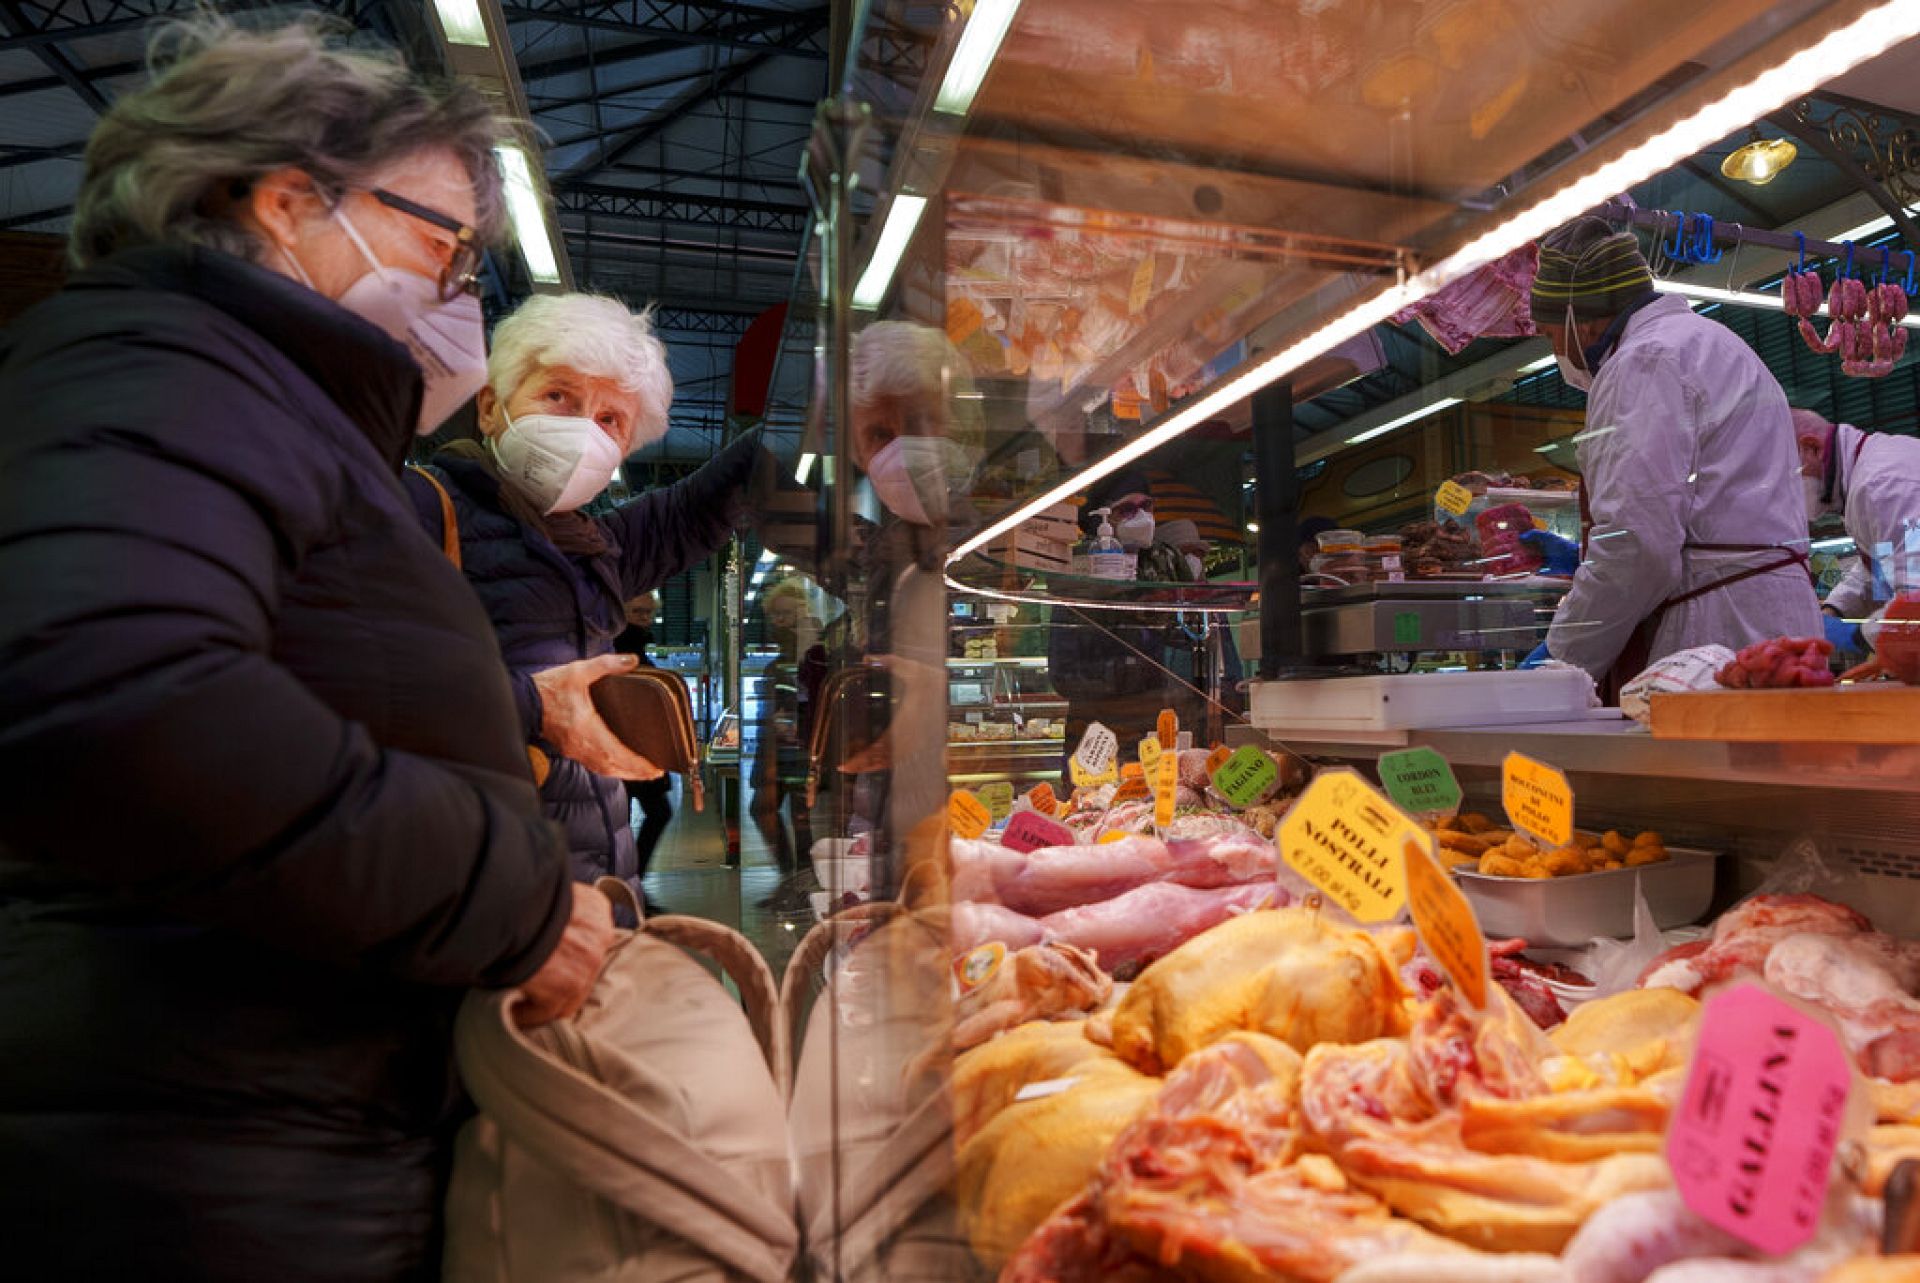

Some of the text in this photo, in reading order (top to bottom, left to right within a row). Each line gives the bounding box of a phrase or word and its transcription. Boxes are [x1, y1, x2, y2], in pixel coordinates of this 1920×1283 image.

[1396, 768, 1441, 784] CORDON
[1411, 783, 1437, 796] BLEU
[1305, 820, 1394, 899] NOSTRALI
[1330, 817, 1389, 869] POLLI
[1728, 1025, 1797, 1218] GALLINA
